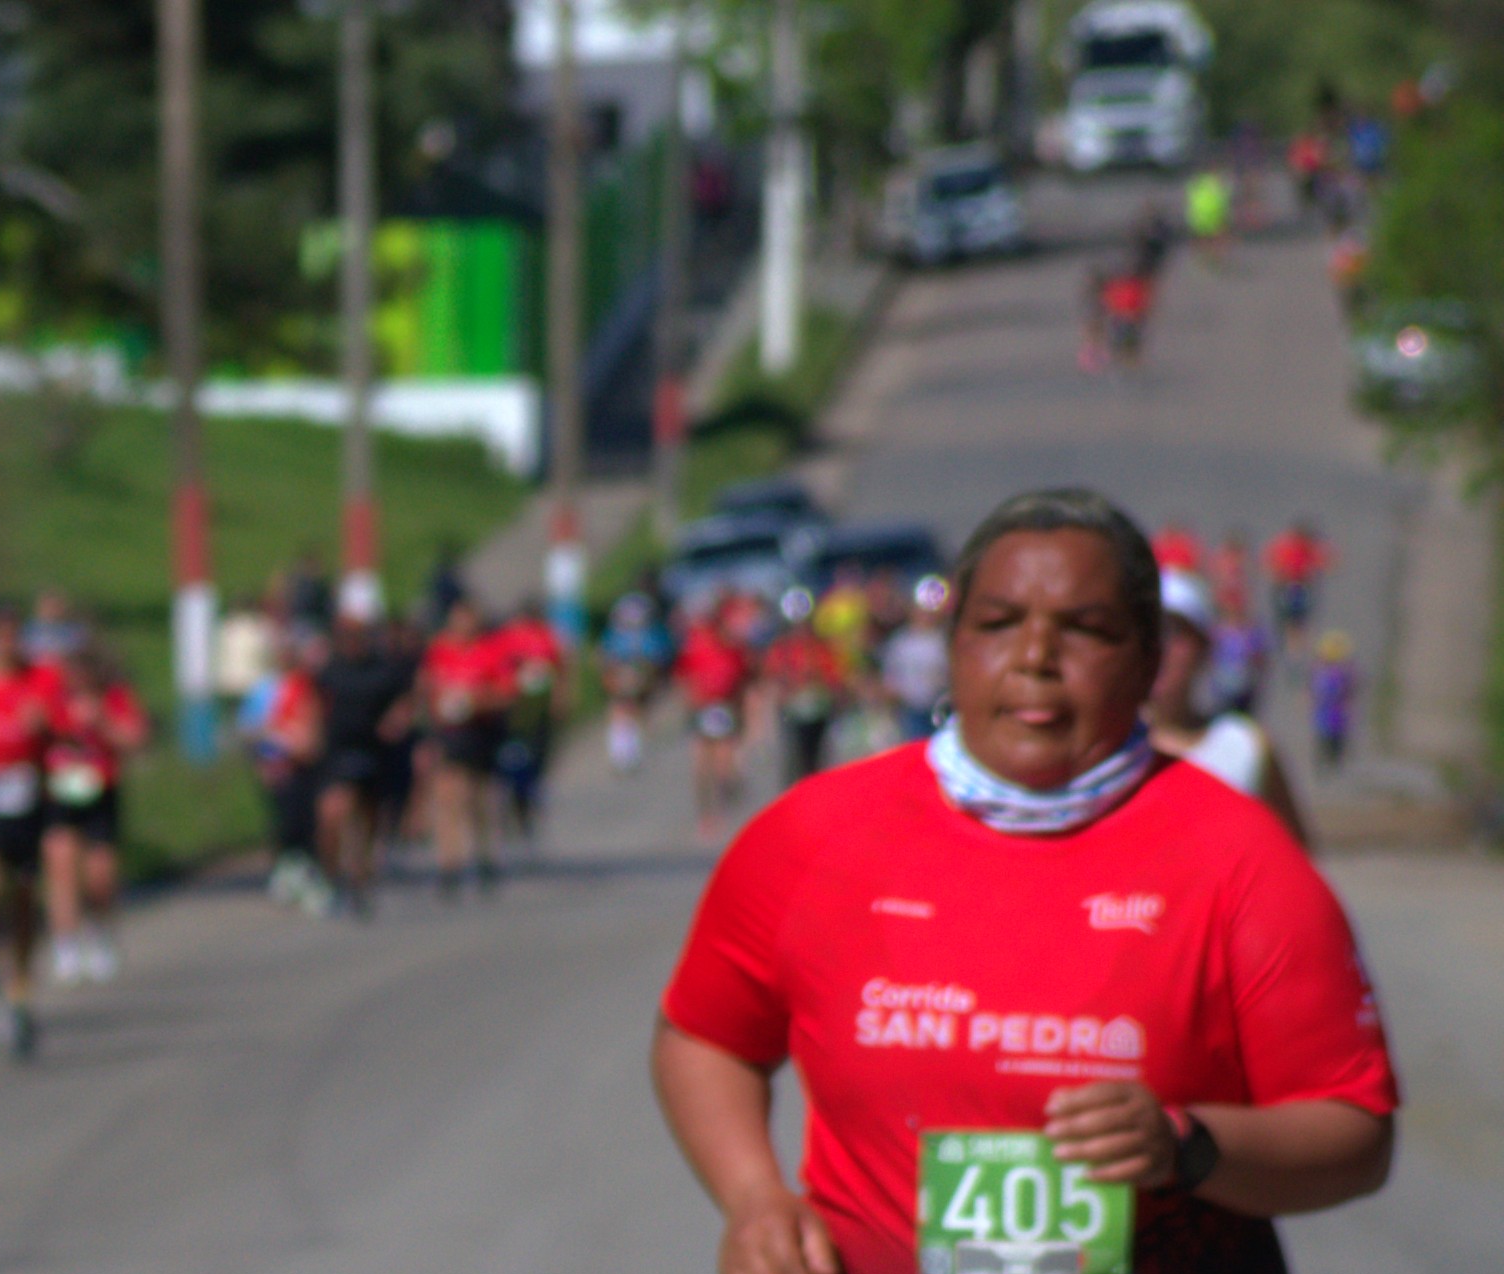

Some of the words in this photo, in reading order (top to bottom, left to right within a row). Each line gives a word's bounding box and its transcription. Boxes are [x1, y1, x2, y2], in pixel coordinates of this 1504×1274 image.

[862, 977, 975, 1012] Corrida
[856, 1008, 950, 1048] SAN
[942, 1164, 1104, 1242] 405
